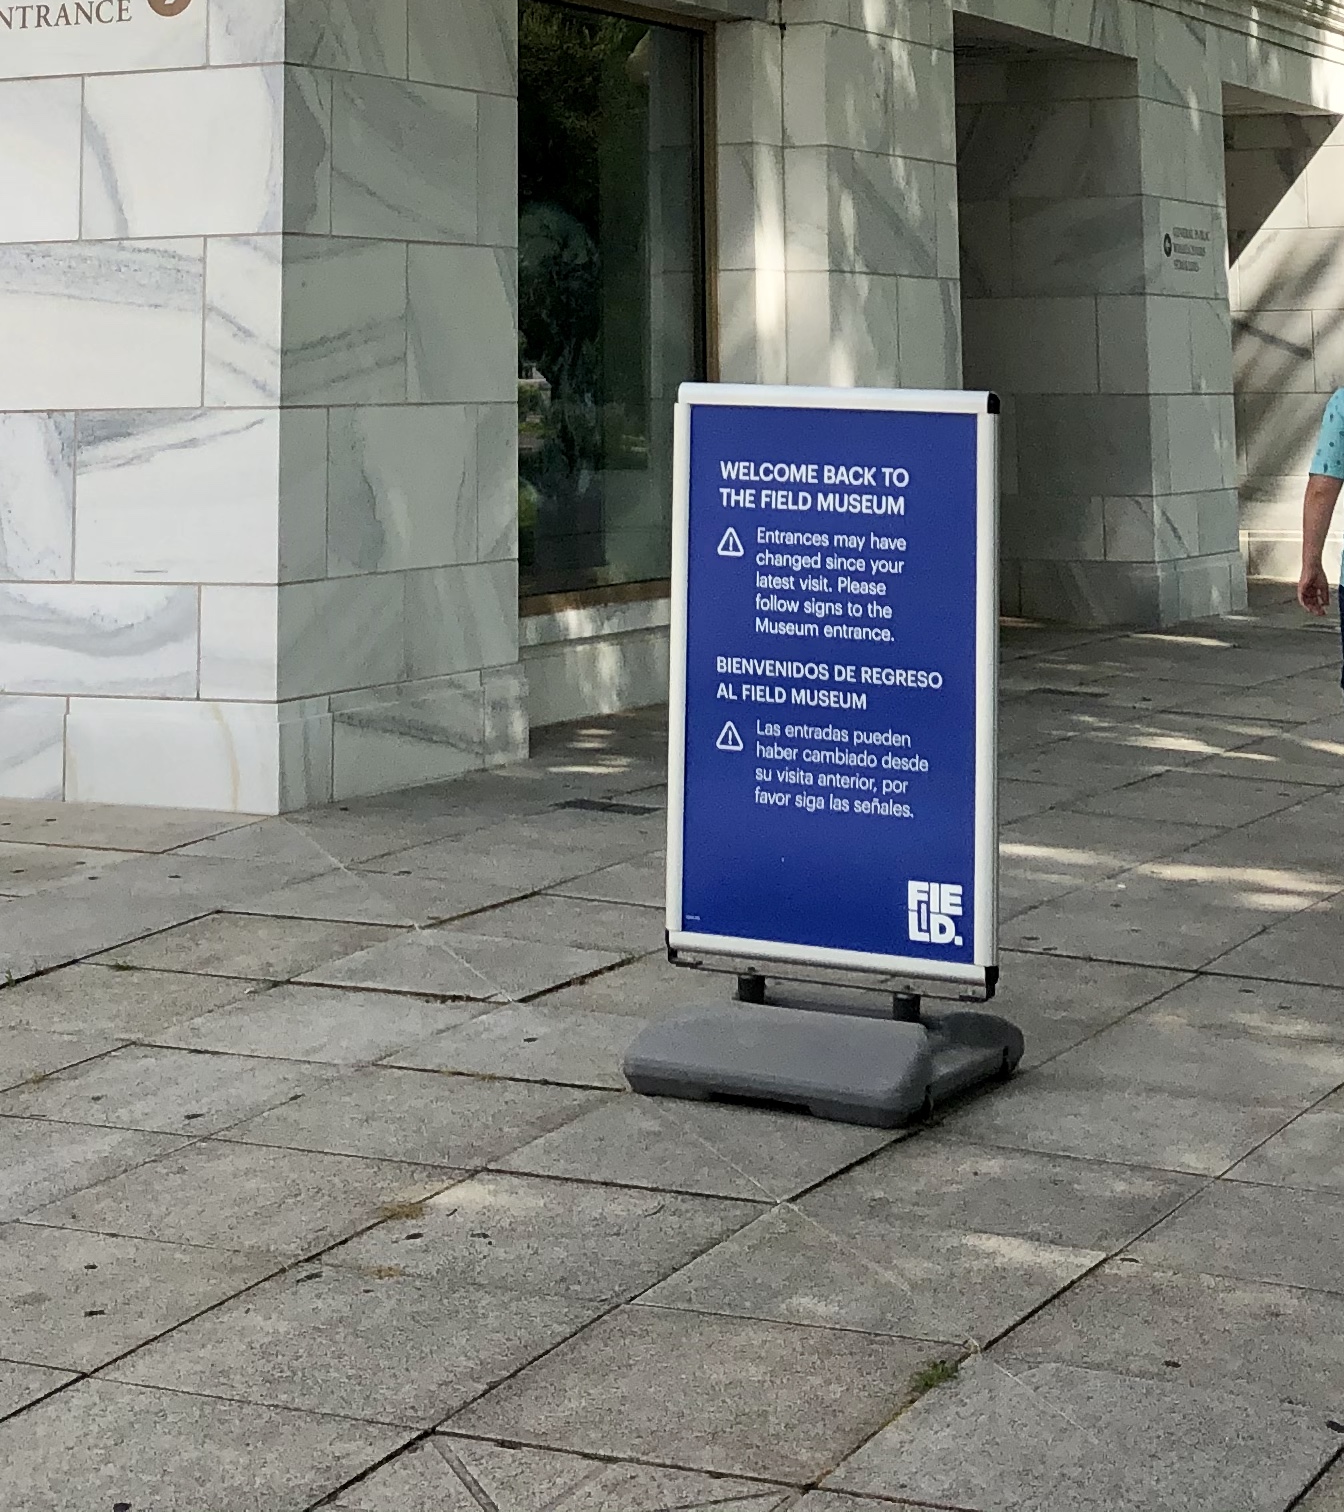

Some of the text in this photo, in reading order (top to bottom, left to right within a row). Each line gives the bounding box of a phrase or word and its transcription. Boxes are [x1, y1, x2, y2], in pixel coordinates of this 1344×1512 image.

[720, 460, 910, 488] WELCOME BACK TO
[719, 487, 905, 515] THE FIELD MUSEUM
[757, 527, 907, 552] Entrances may have
[756, 549, 905, 575] changed since your
[756, 571, 887, 596] latest visit. Please
[755, 593, 893, 619] follow signs to the
[755, 617, 895, 642] Museum entrance.
[716, 656, 943, 689] BIENVENIDOS DE REGRESO
[716, 683, 867, 710] AL FIELD MUSEUM
[756, 719, 911, 748] Las entradas pueden
[756, 741, 929, 773] haber cambiado desde
[755, 767, 909, 795] su visita anterior, por
[755, 786, 914, 819] favor siga las señales.
